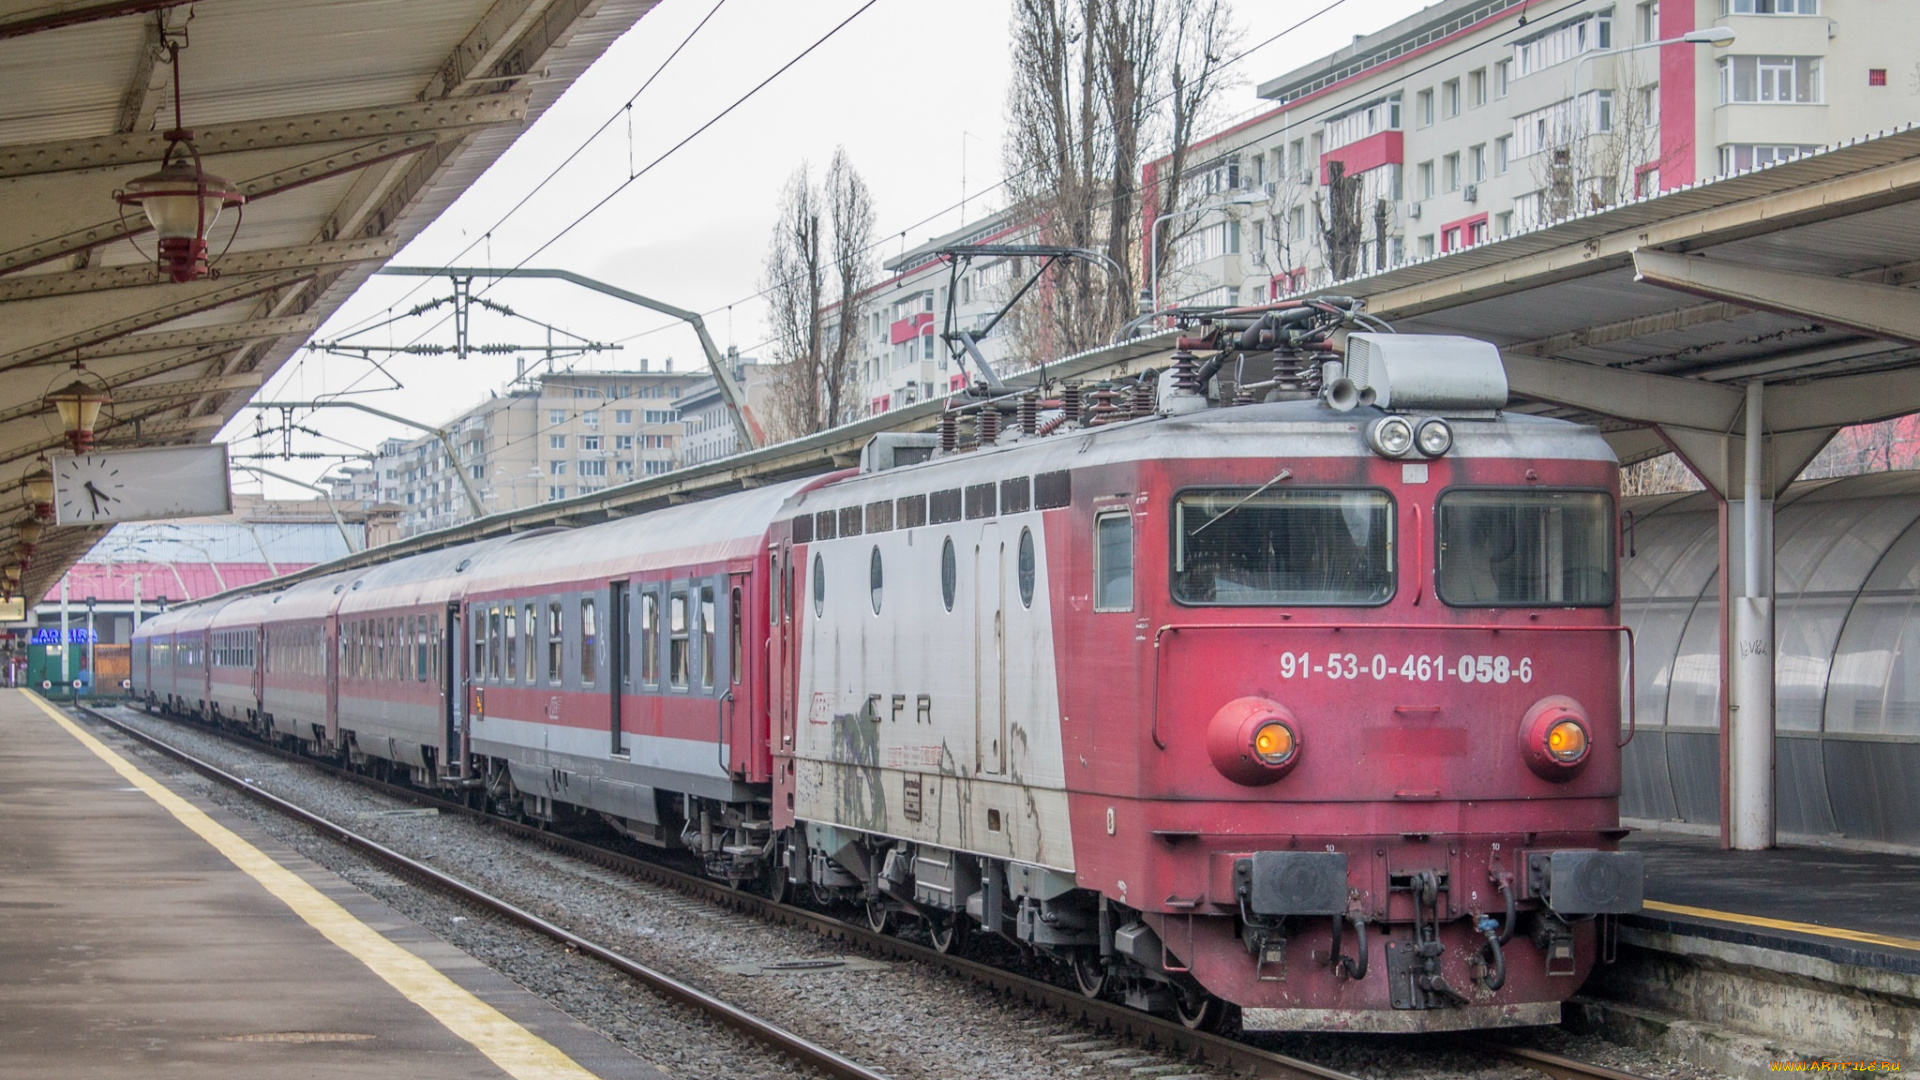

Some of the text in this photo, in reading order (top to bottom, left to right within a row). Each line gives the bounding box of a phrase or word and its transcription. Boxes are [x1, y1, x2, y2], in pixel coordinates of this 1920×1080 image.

[692, 587, 698, 630] 2
[1280, 652, 1533, 684] 91-53-0-461-058-6
[1471, 891, 1478, 900] 5
